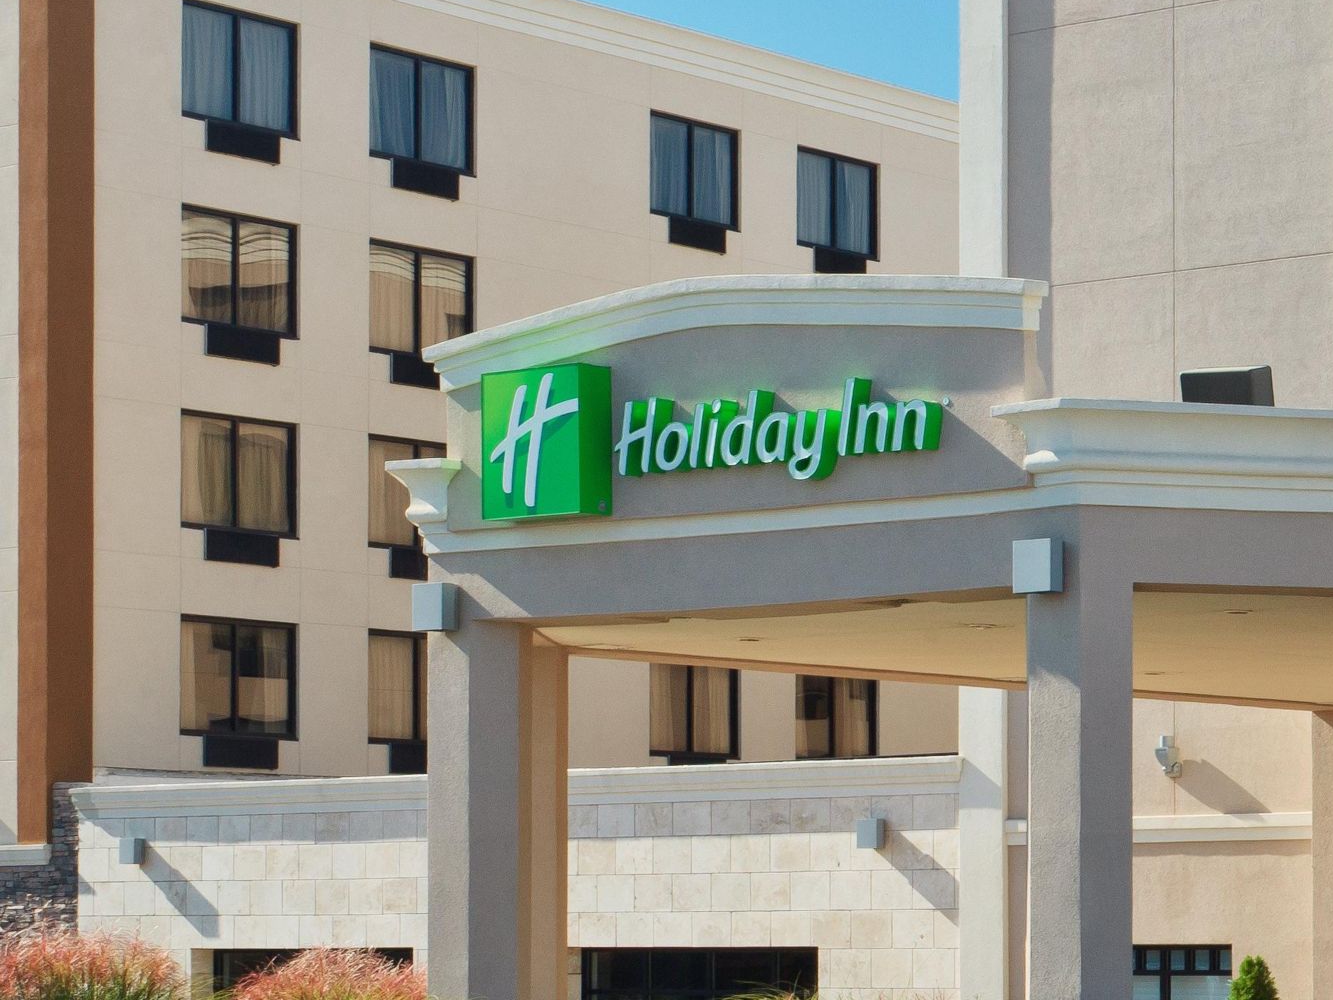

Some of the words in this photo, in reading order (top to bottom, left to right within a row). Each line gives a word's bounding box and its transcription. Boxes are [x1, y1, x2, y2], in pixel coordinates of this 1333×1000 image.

[490, 372, 579, 507] H
[614, 390, 838, 480] Holiday
[837, 377, 942, 457] Inn
